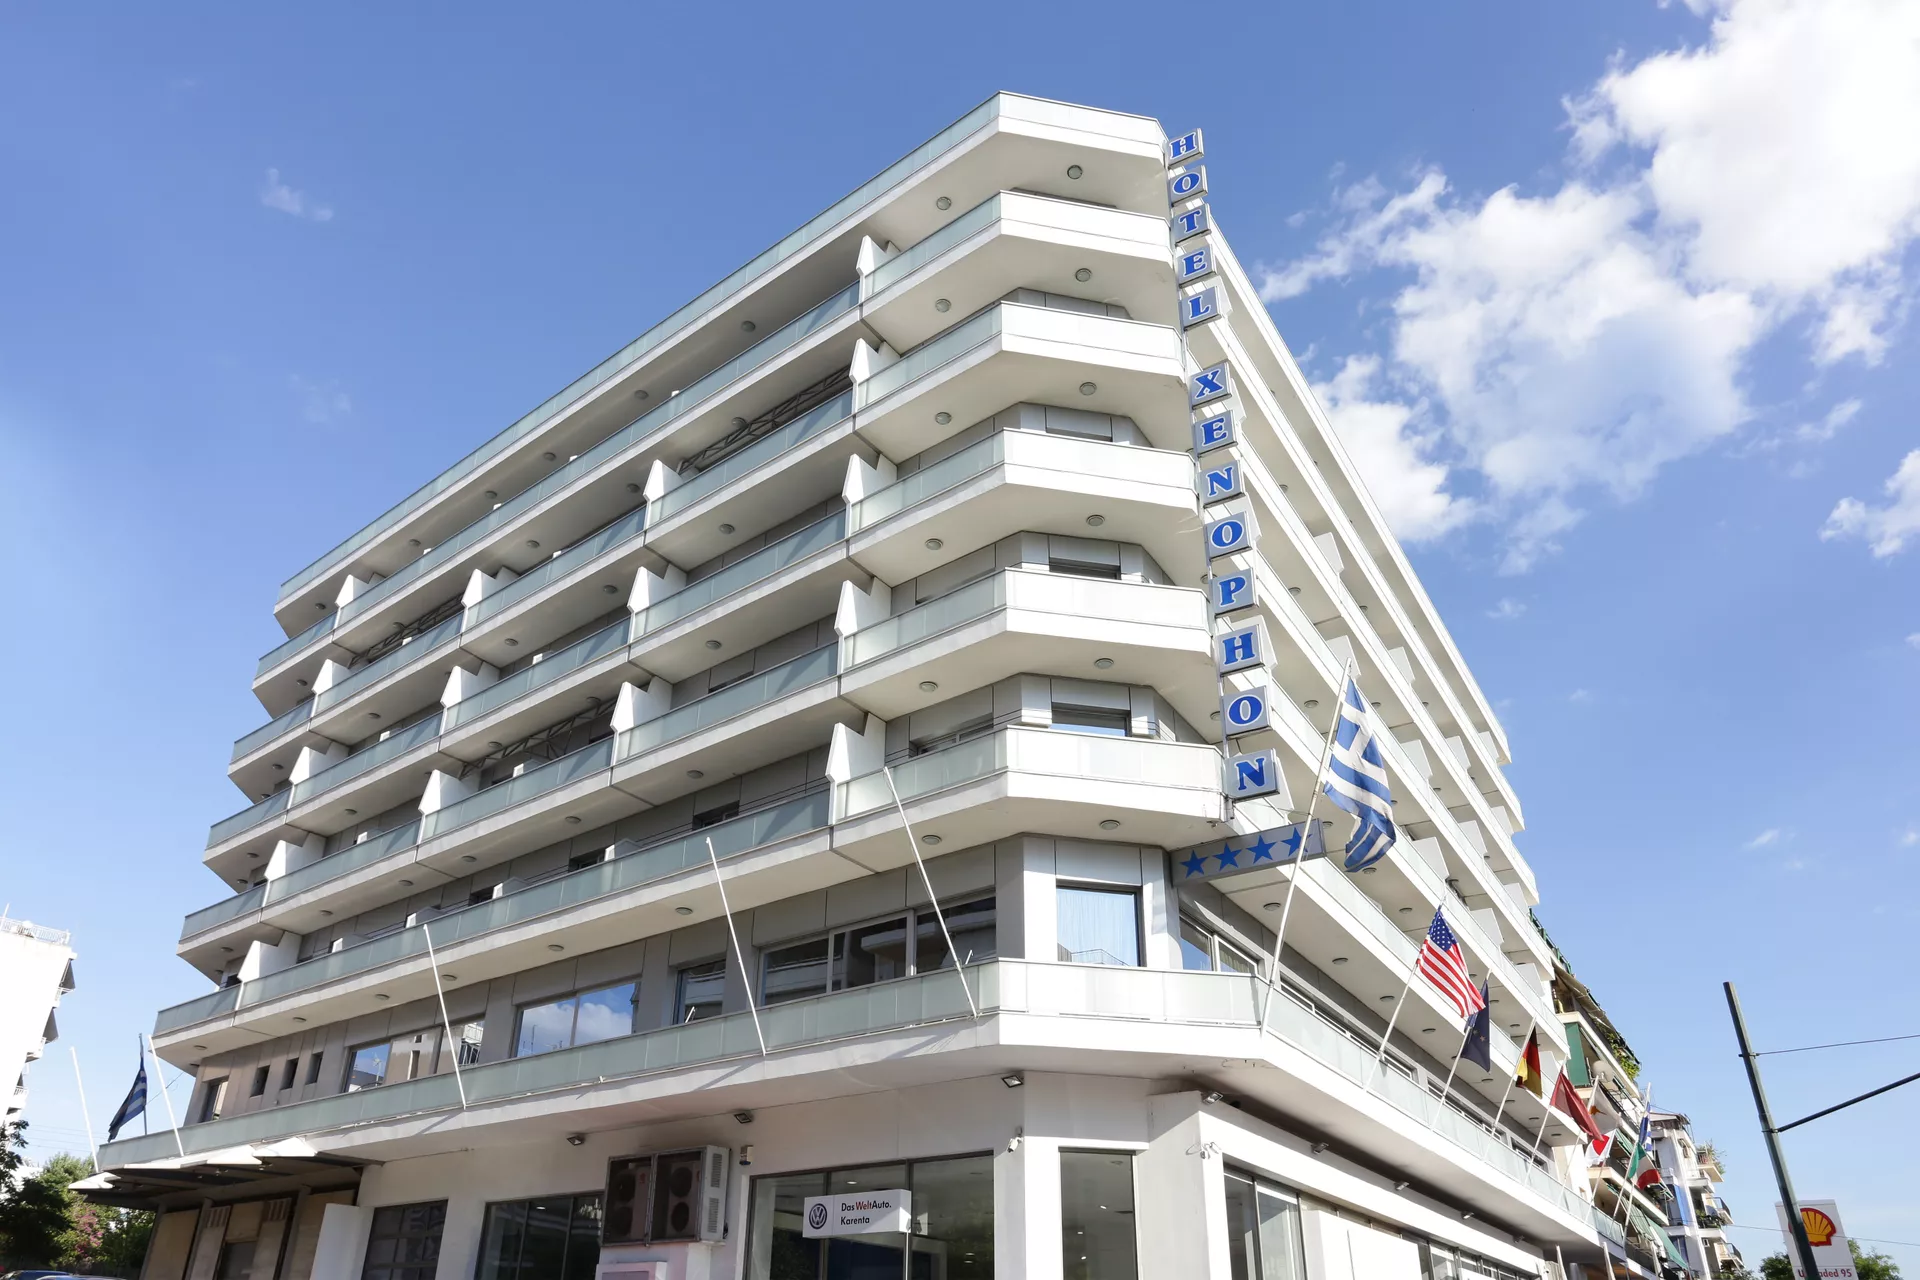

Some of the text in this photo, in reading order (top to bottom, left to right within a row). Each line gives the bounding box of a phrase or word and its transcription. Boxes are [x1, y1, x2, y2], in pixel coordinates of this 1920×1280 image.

[1170, 132, 1210, 319] HOTEL
[1195, 369, 1265, 791] XENOPHON
[841, 1200, 892, 1211] Das WeltAuto.
[841, 1216, 870, 1225] Karenta
[1798, 1269, 1852, 1278] Uaded 95
